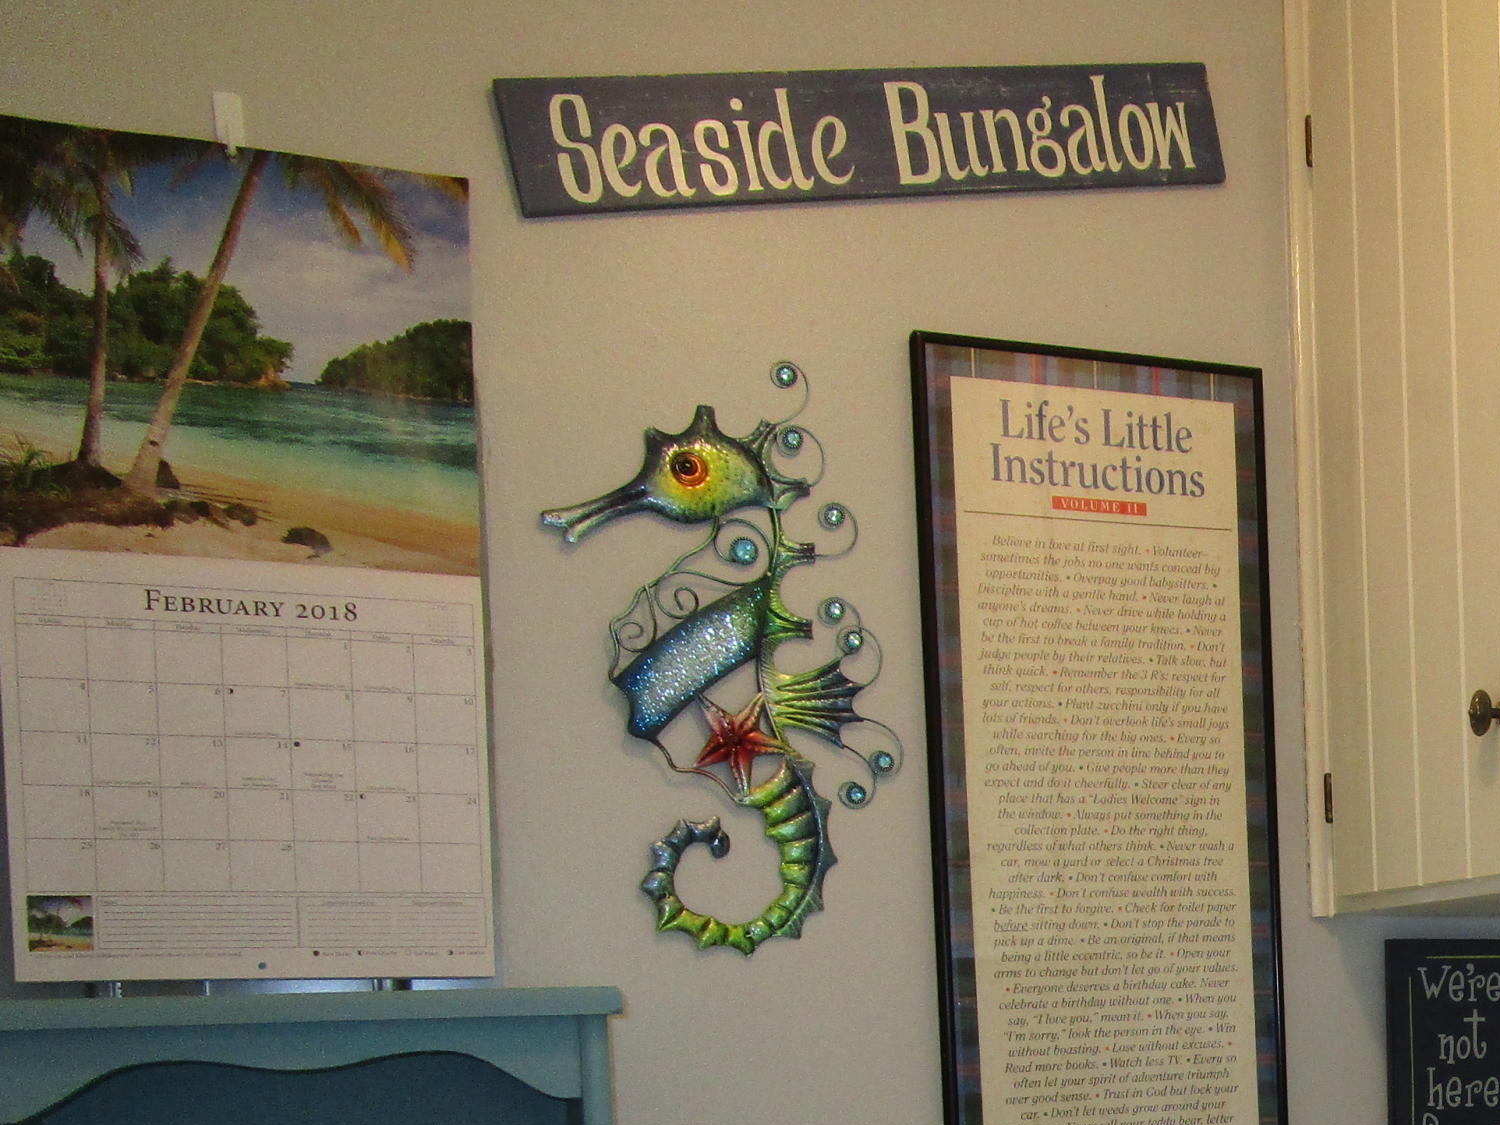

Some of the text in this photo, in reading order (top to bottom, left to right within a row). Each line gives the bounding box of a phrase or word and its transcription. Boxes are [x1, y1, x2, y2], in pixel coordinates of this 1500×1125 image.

[548, 74, 1197, 204] Seaside Bungalow
[999, 399, 1193, 454] Life's Little
[989, 442, 1206, 499] Instructions
[1060, 496, 1140, 516] VOLUME II
[1121, 575, 1145, 587] good
[144, 588, 359, 622] FEBRUARY 2018
[1111, 825, 1126, 835] Do
[1129, 825, 1145, 835] the
[1438, 1008, 1487, 1064] not
[1005, 1062, 1031, 1074] Read
[1110, 1057, 1141, 1069] Watch
[1193, 1054, 1223, 1066] Every
[1426, 1067, 1500, 1110] here
[1082, 1106, 1095, 1116] let
[1132, 1104, 1159, 1114] grow
[1161, 1100, 1198, 1112] around
